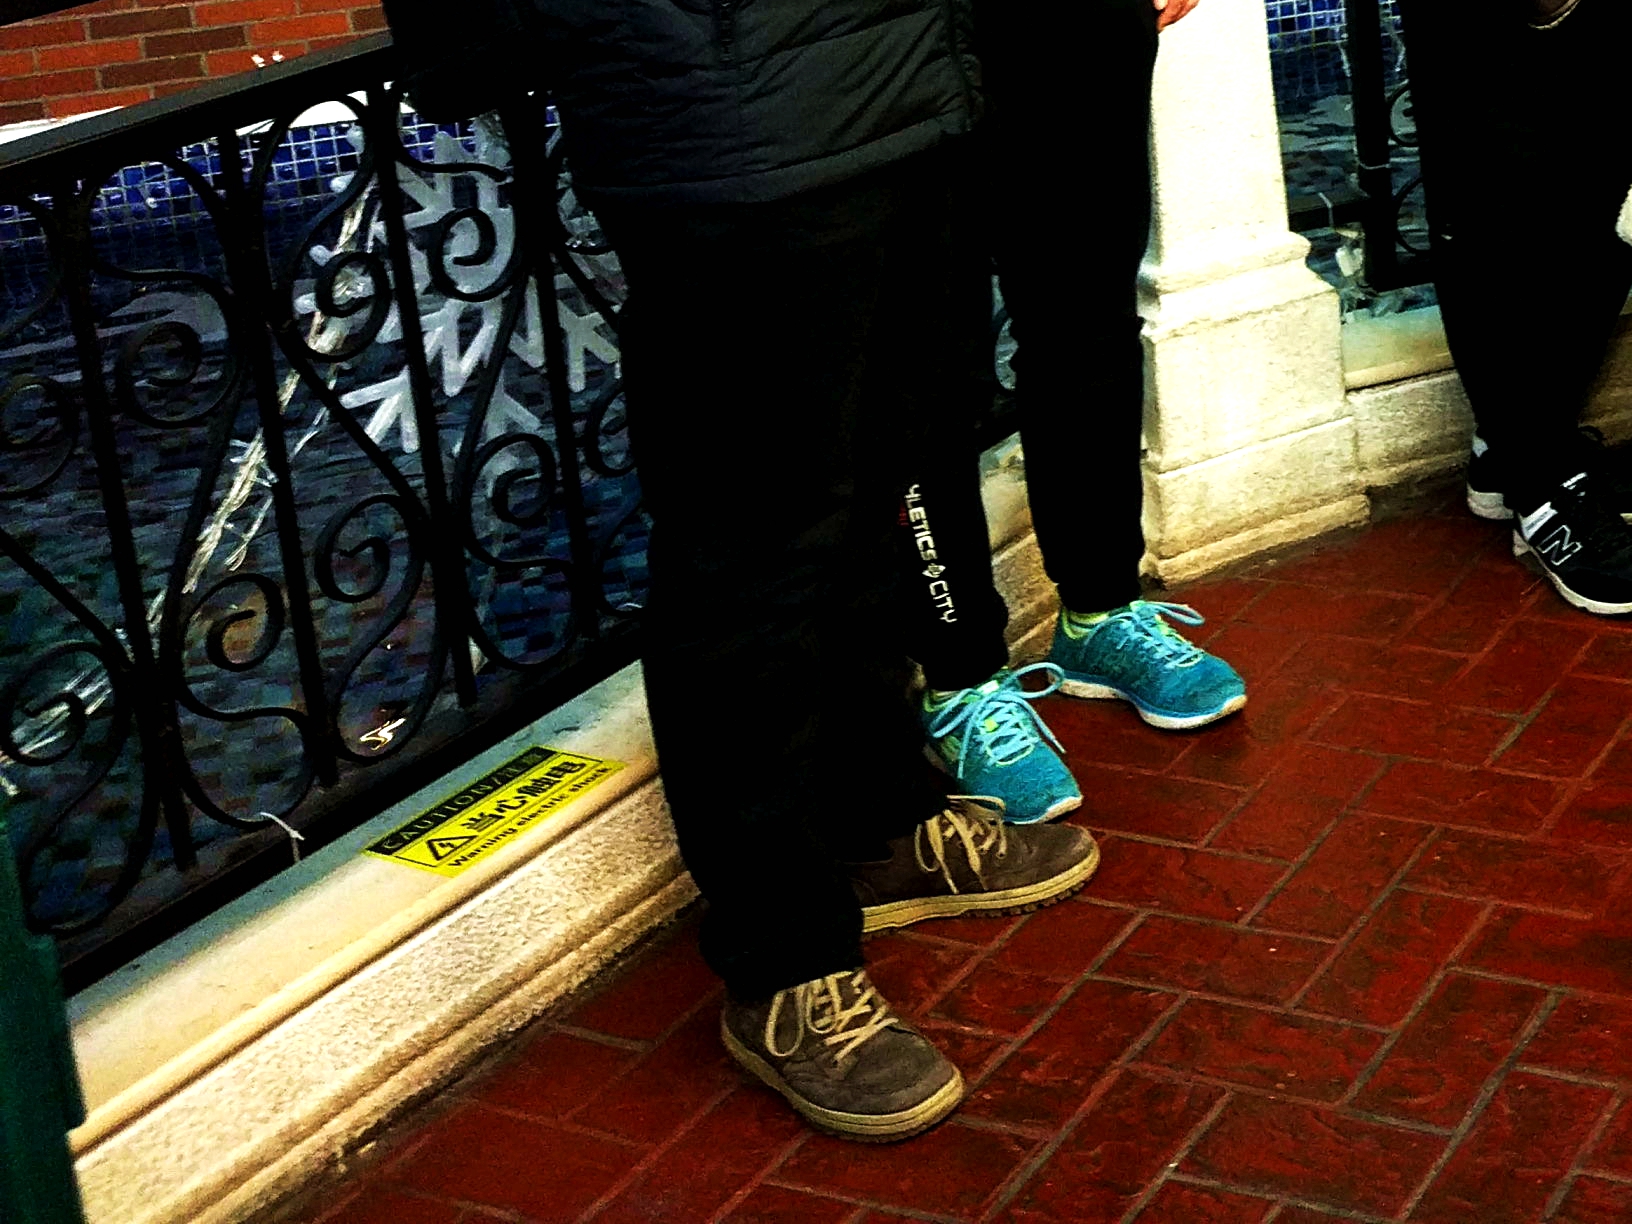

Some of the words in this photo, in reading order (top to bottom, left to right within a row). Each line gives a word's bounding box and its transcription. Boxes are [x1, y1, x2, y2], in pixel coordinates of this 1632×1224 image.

[929, 580, 958, 623] CITY
[448, 826, 518, 867] Warning
[516, 792, 570, 827] electric
[571, 766, 615, 794] shock
[460, 761, 587, 833] 当心触电
